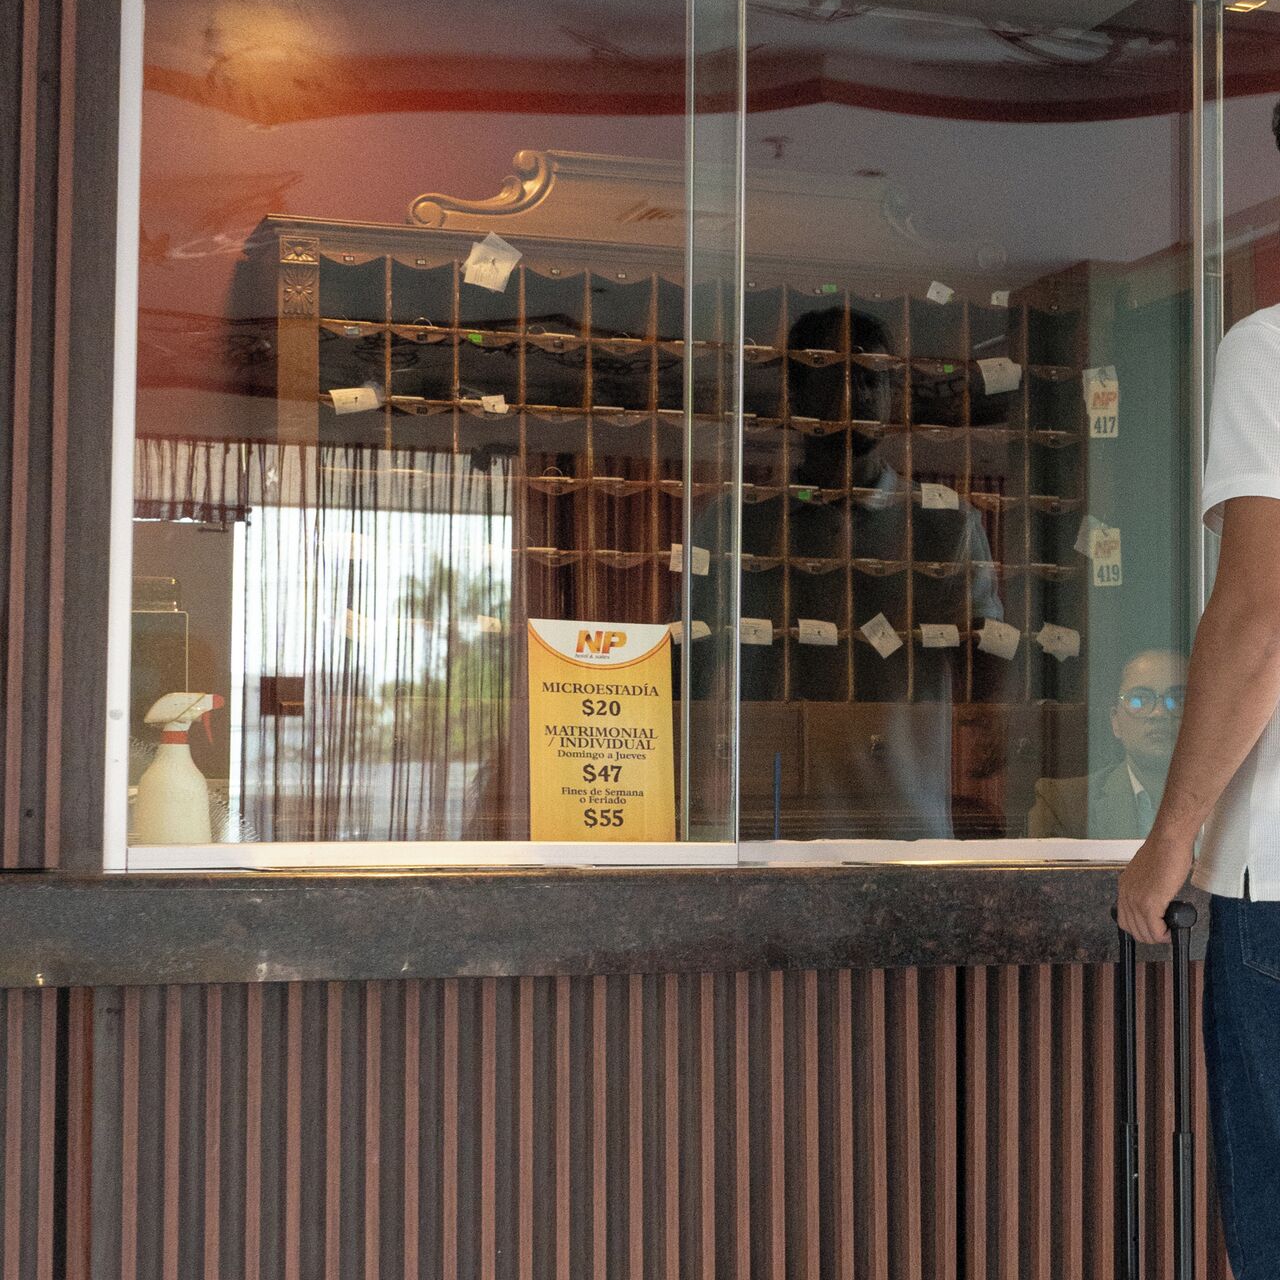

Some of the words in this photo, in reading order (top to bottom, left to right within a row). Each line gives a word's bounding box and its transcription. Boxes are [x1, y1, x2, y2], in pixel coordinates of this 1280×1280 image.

[1094, 416, 1117, 434] 417
[1097, 564, 1120, 583] 419
[575, 629, 627, 654] NP
[542, 681, 659, 697] MICROESTADÍA
[582, 699, 621, 717] $20
[544, 724, 659, 740] MATRIMONIAL
[560, 737, 656, 751] INDIVIDUAL
[557, 750, 605, 760] Domingo
[615, 751, 646, 761] Jueves
[582, 764, 622, 783] $47
[561, 786, 588, 796] Fines
[590, 786, 603, 796] de
[604, 787, 644, 797] Semana
[588, 795, 627, 805] Feriado
[584, 809, 624, 828] $55
